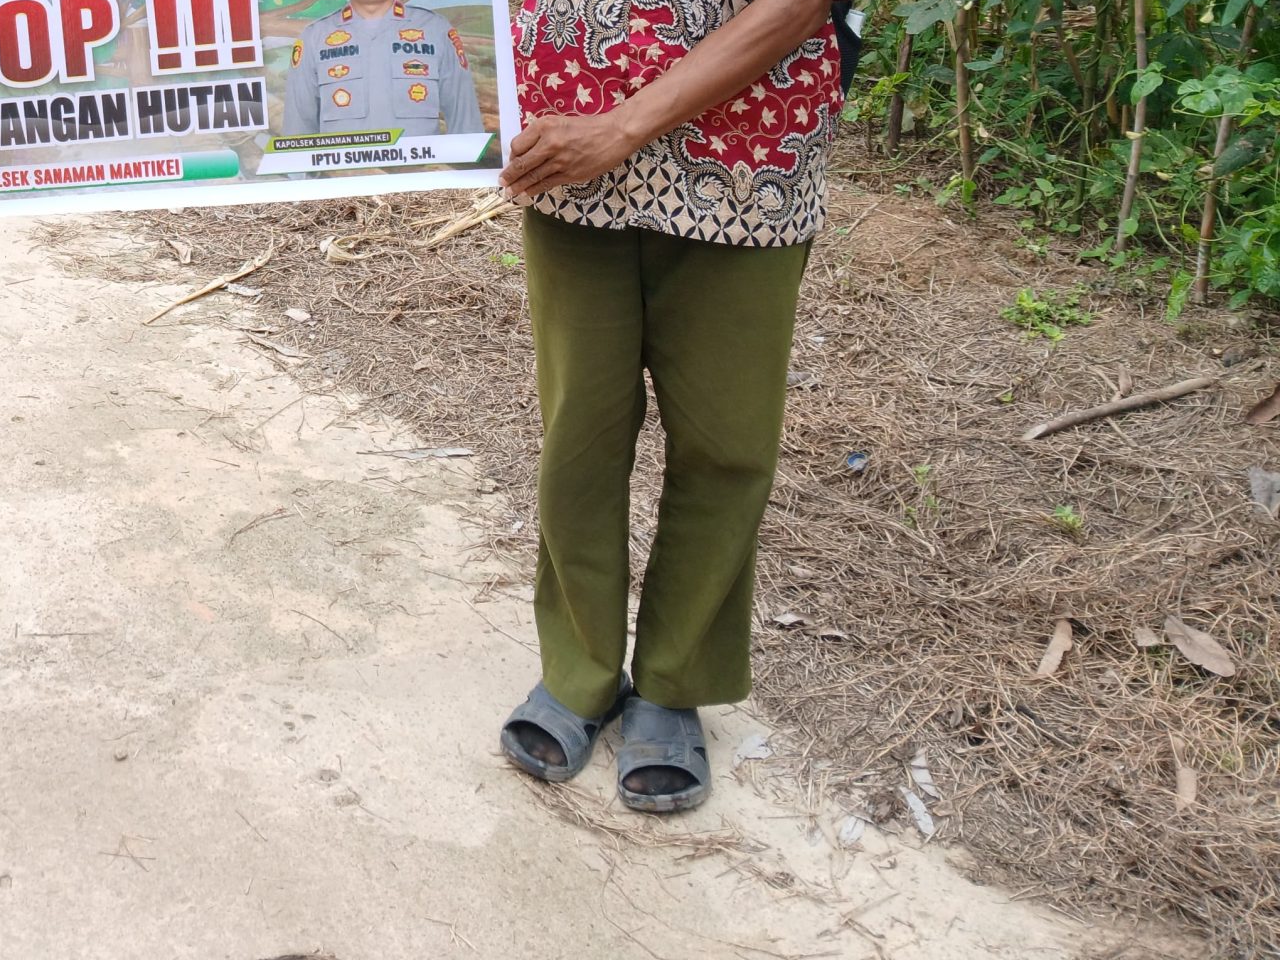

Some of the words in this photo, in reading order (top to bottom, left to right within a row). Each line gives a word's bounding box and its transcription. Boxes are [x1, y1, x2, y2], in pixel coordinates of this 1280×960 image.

[319, 44, 359, 61] SUWARDI
[392, 42, 435, 55] POLRI
[136, 81, 265, 135] HUTAN
[275, 139, 314, 149] KAPOLSEK
[316, 136, 352, 146] SANAMAN
[353, 133, 389, 143] MANTIKEI
[311, 152, 341, 166] IPTU
[344, 149, 407, 164] SUWARDI,
[410, 147, 436, 160] S.H.
[34, 164, 105, 186] SANAMAN
[110, 158, 181, 180] MANTIKEI
